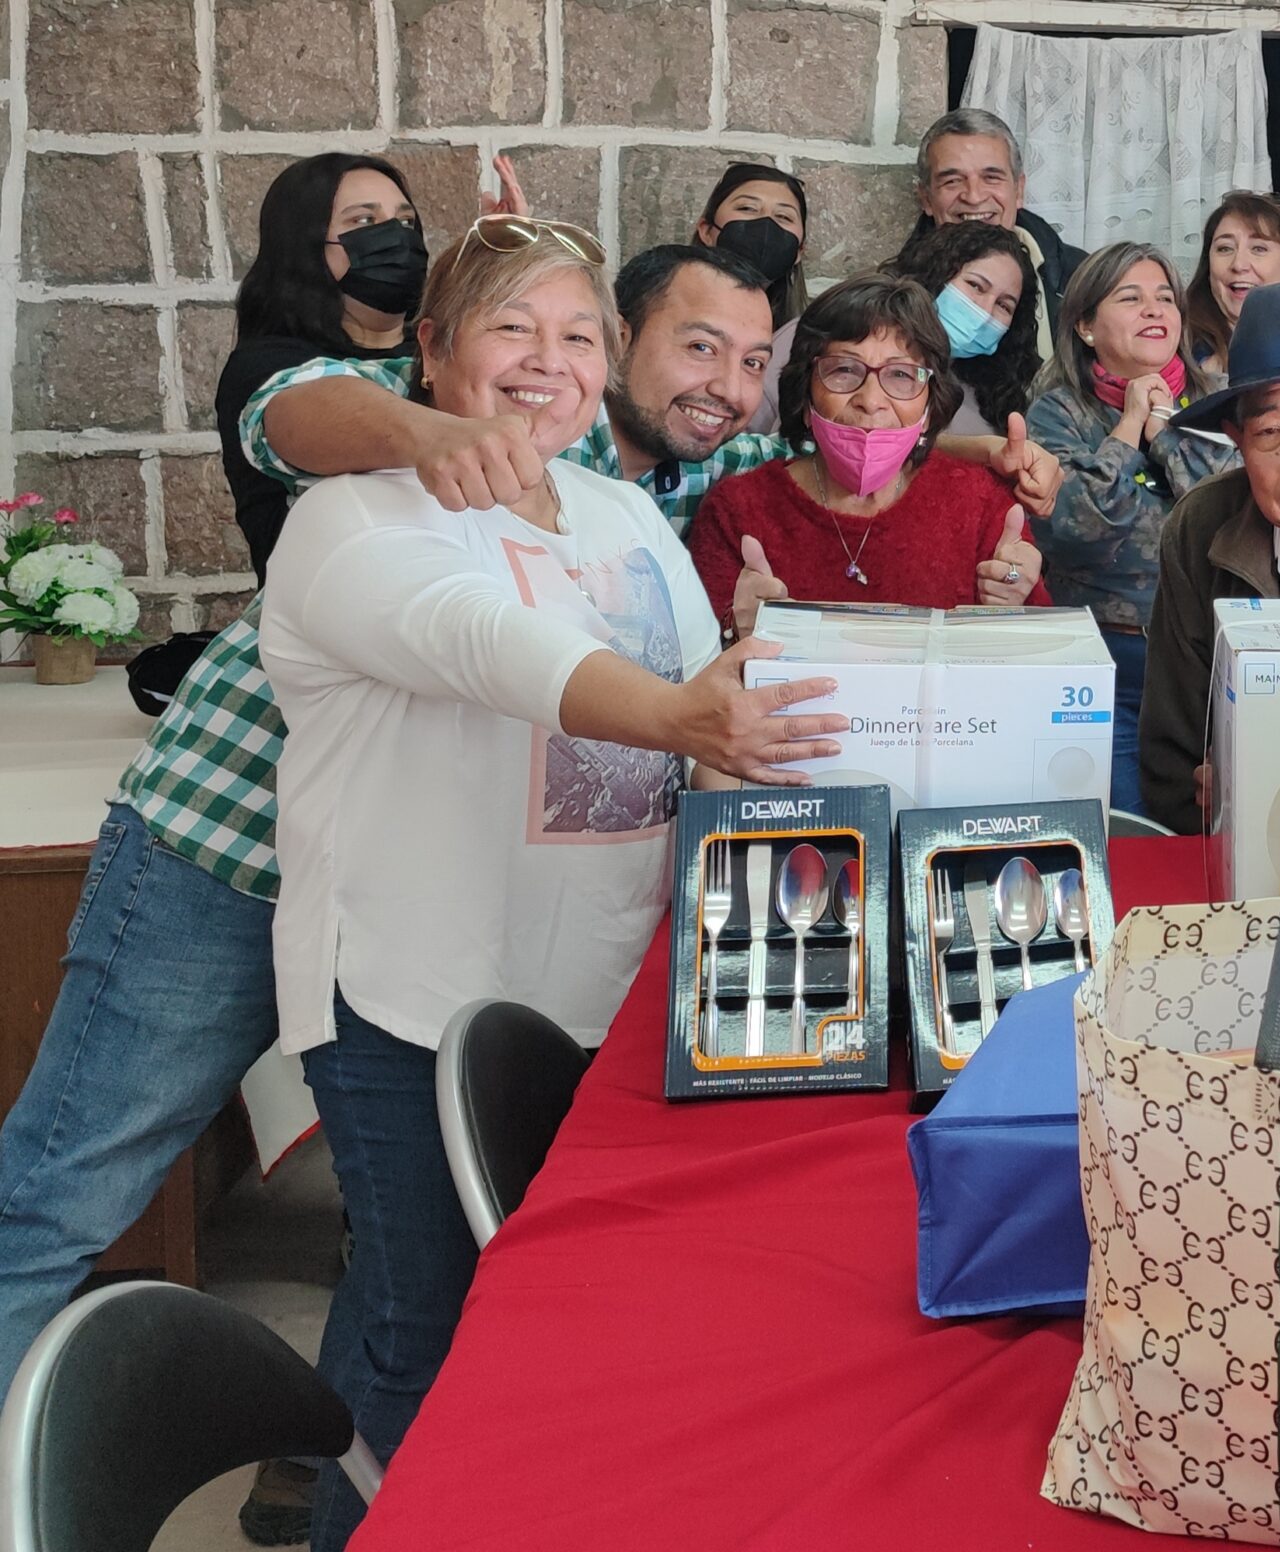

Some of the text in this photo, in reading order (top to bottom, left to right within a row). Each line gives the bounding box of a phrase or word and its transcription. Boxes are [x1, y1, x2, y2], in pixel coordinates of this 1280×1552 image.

[1061, 686, 1094, 707] 30
[901, 705, 946, 715] Porcin
[1061, 712, 1093, 723] pieces
[968, 716, 998, 734] Set
[870, 738, 896, 749] Juego
[898, 738, 908, 747] de
[741, 799, 825, 820] DEWART
[962, 815, 1042, 836] DEWART
[826, 1051, 866, 1062] PIEZAS
